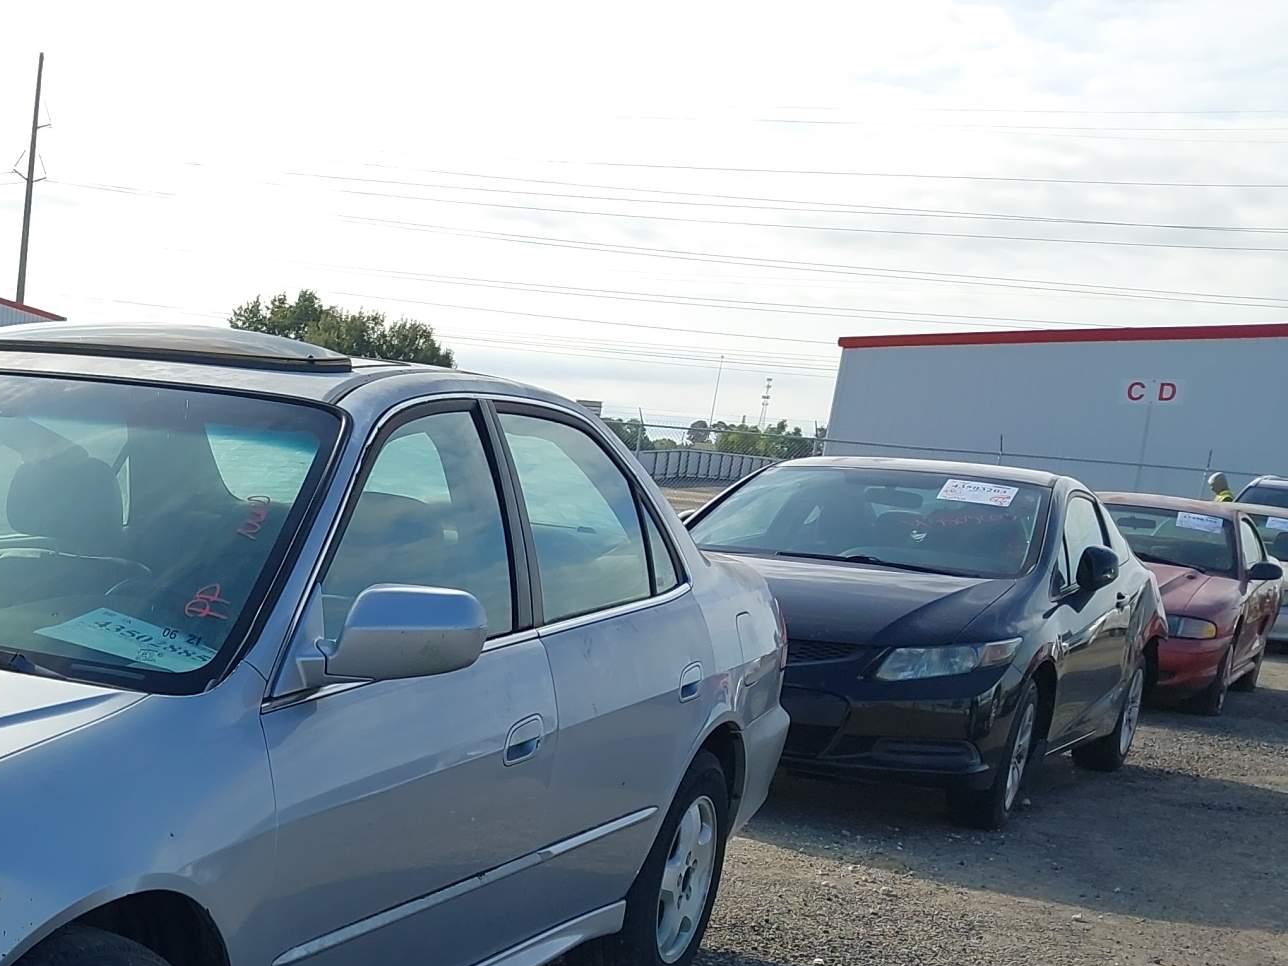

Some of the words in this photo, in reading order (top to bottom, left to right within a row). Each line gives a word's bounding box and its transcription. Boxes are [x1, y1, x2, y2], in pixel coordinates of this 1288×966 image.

[1127, 381, 1146, 401] C
[1158, 382, 1177, 401] D
[162, 627, 179, 640] 06
